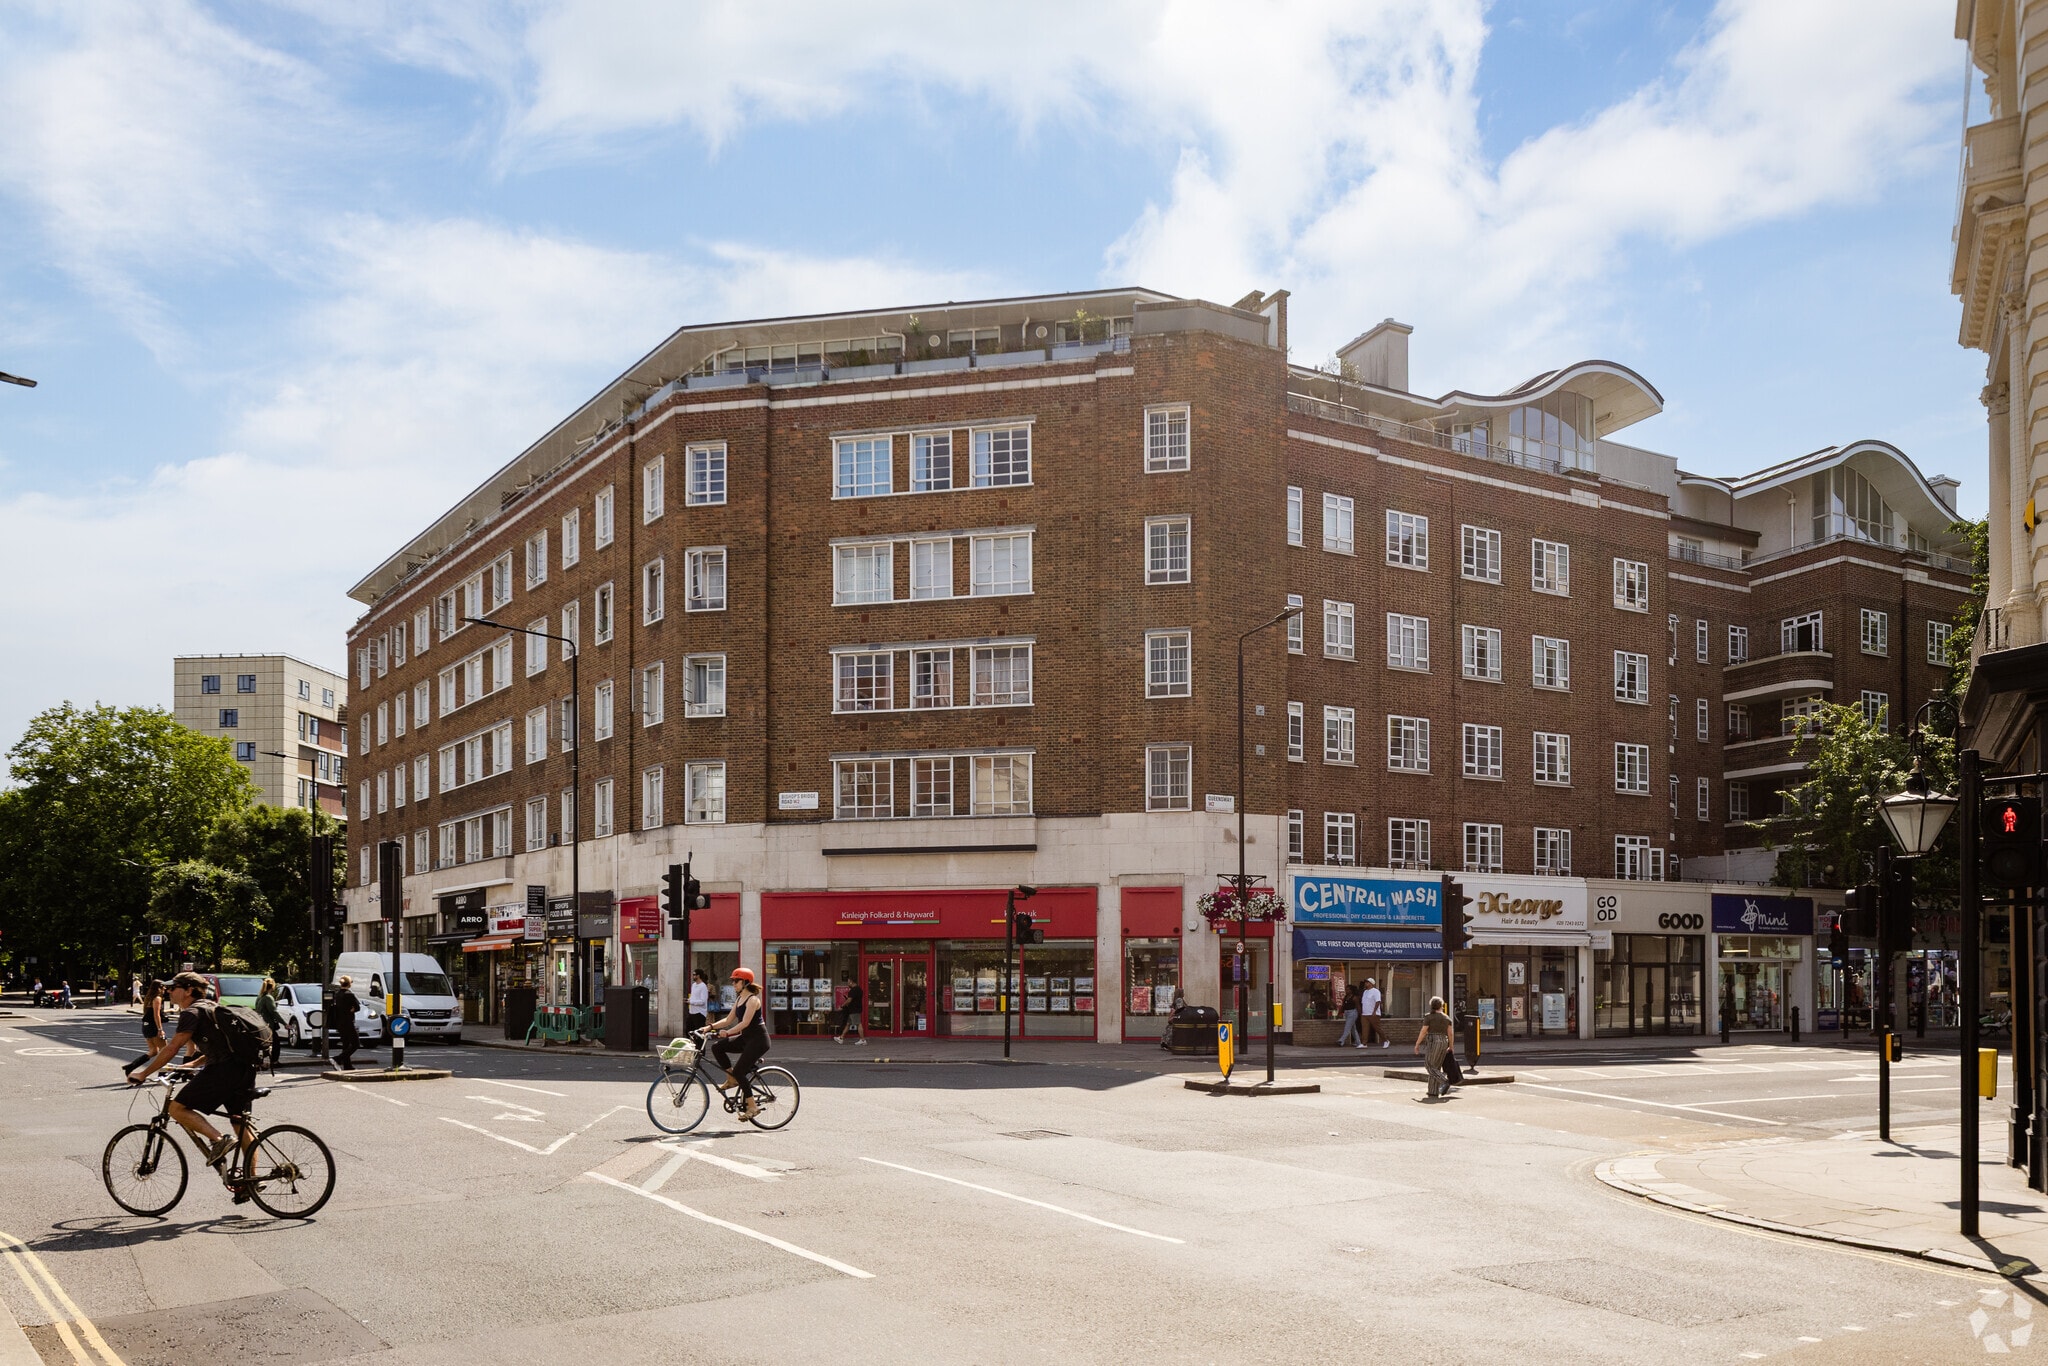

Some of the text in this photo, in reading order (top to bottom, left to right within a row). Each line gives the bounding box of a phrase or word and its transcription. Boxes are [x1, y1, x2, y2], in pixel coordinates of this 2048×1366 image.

[455, 896, 467, 905] ARRO
[1299, 882, 1436, 912] CENTRAL WASH
[842, 911, 868, 920] Kinleigh
[903, 911, 934, 919] Hayward
[1658, 913, 1704, 929] GOOD
[1670, 993, 1692, 1001] TO LET
